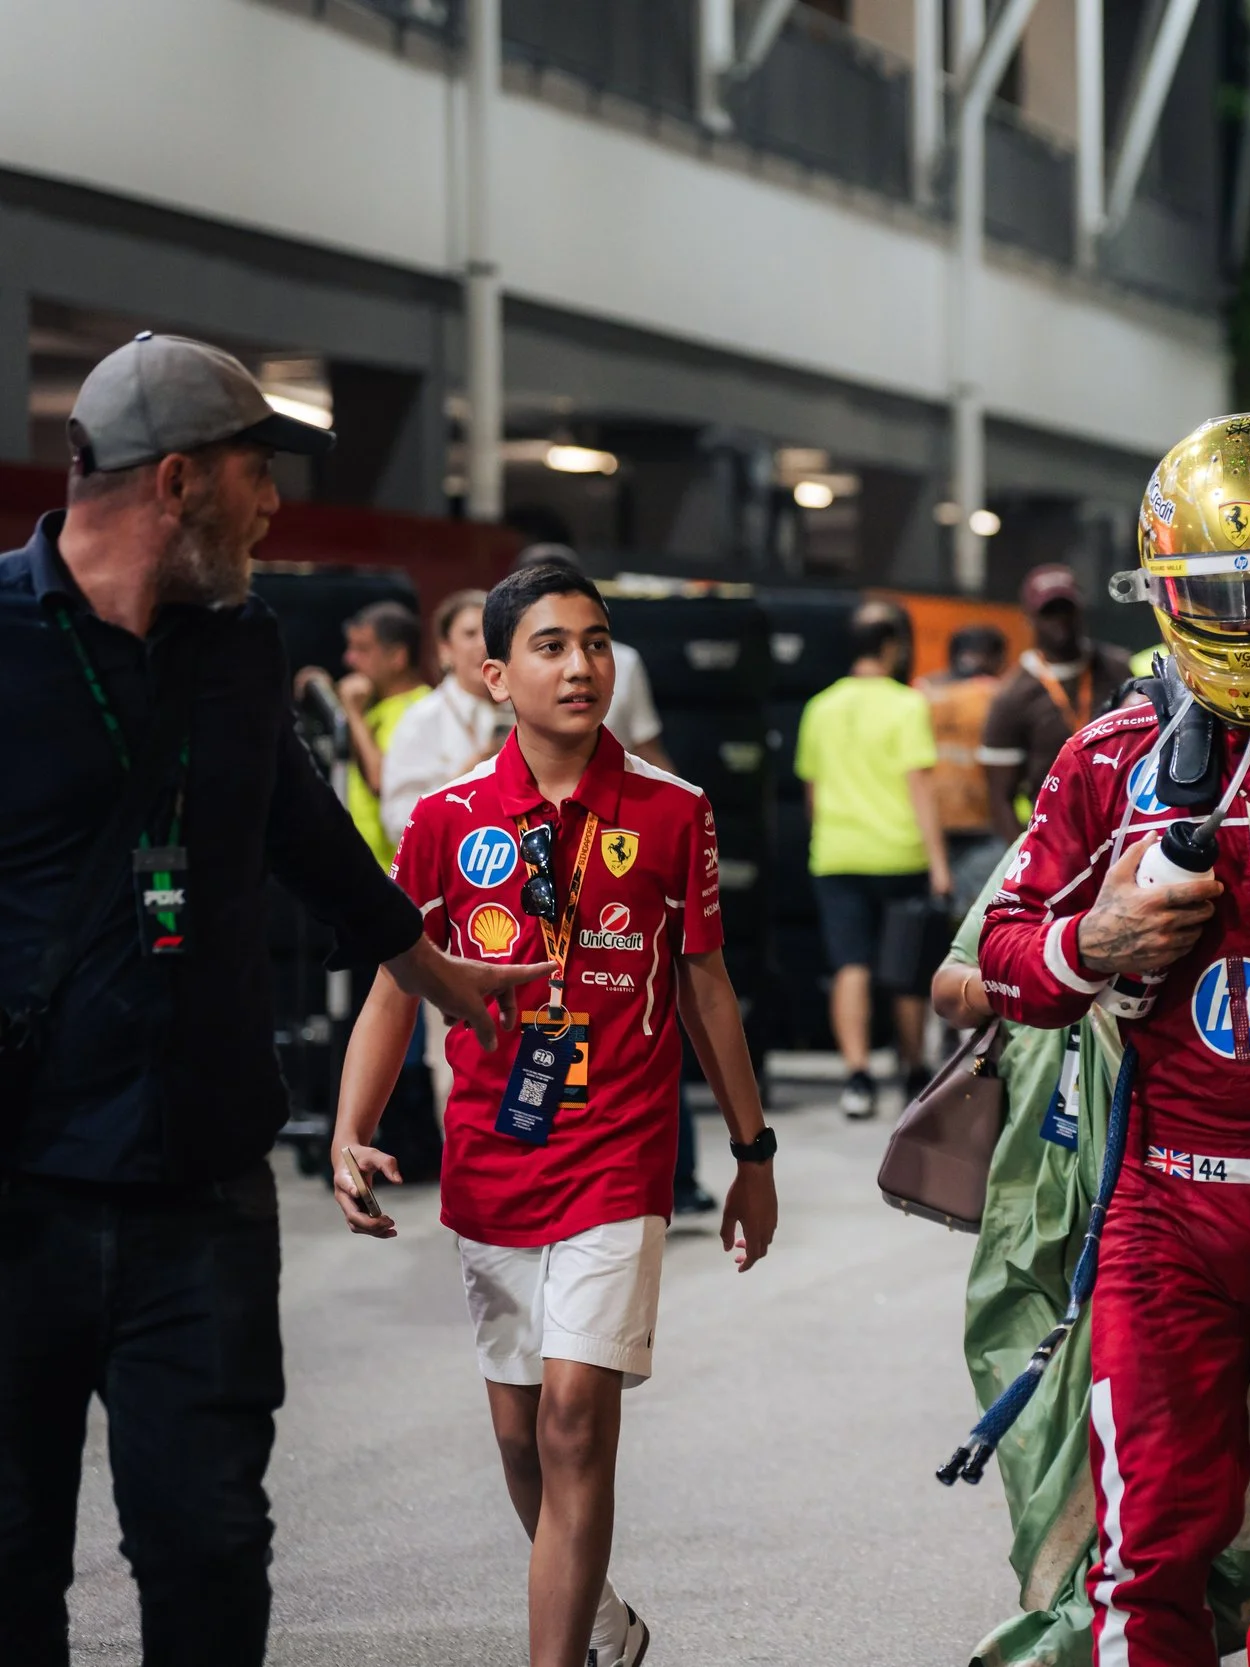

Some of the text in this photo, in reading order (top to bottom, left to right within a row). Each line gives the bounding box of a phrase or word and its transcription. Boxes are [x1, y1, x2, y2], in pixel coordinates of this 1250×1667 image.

[577, 822, 595, 866] SINGAPORE
[466, 829, 511, 887] hp
[580, 931, 642, 949] UniCredit
[534, 1051, 553, 1065] FIA
[1199, 1158, 1228, 1182] 44
